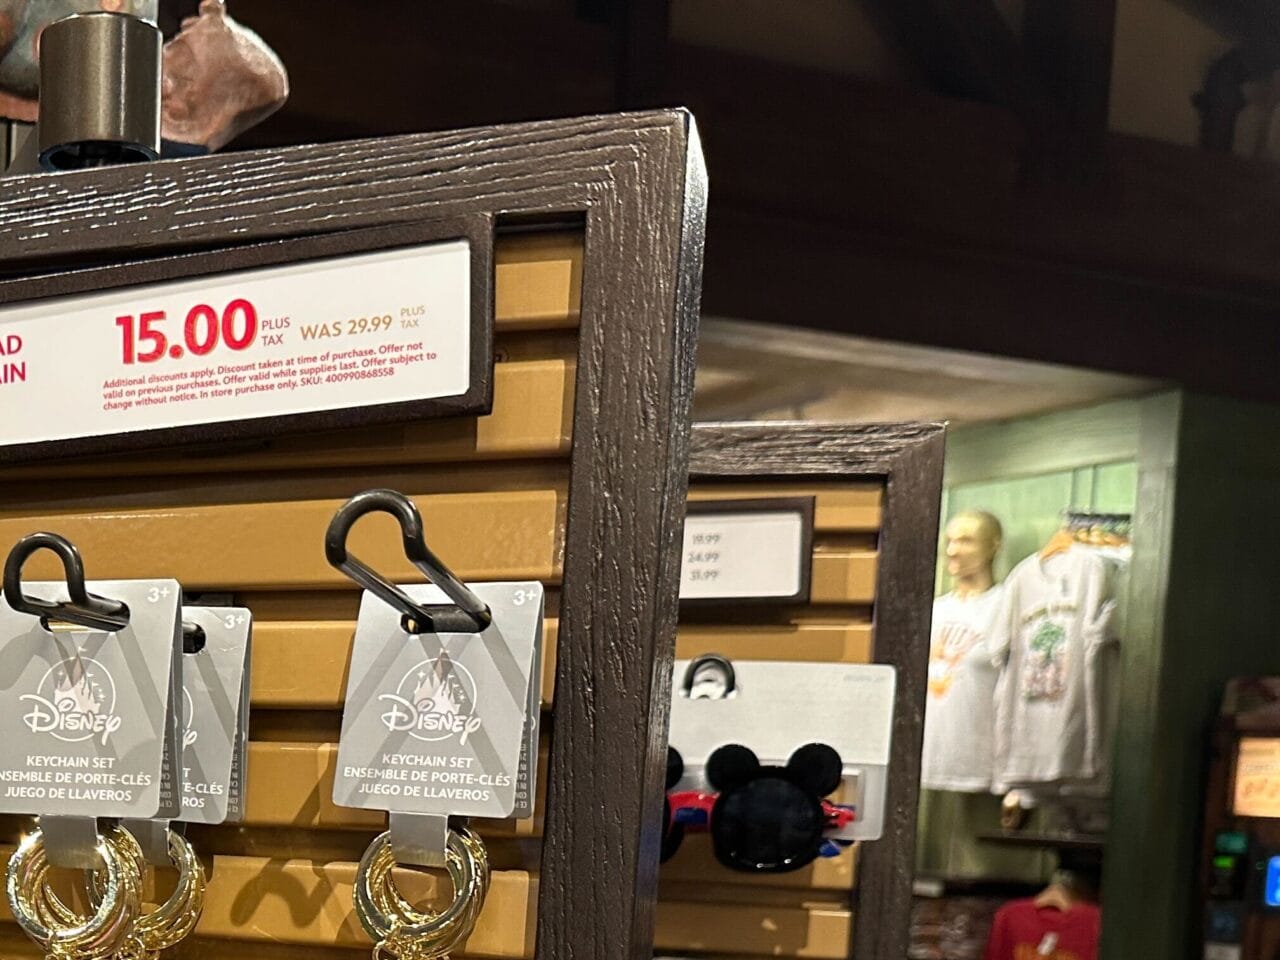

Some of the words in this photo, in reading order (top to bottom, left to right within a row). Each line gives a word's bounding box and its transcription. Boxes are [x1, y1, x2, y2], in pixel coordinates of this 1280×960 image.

[400, 305, 425, 317] PLUS
[116, 298, 258, 365] 15.00
[262, 317, 290, 330] PLUS
[300, 322, 342, 340] WAS
[347, 315, 393, 335] 29.99
[400, 319, 419, 329] TAX
[262, 334, 284, 346] TAX
[103, 375, 146, 389] Additional
[148, 371, 188, 384] discounts
[190, 368, 216, 379] apply.
[217, 362, 256, 375] Discount
[258, 359, 284, 371] taken
[286, 358, 295, 367] at
[297, 355, 318, 365] time
[320, 352, 330, 362] of
[332, 349, 377, 363] purchase.
[378, 342, 405, 355] Offer
[406, 341, 423, 351] not
[103, 388, 123, 400] valid
[125, 388, 136, 398] on
[138, 384, 174, 398] previous
[176, 380, 221, 393] purchases.
[223, 373, 247, 385] Offer
[248, 370, 270, 382] valid
[272, 365, 297, 379] while
[299, 361, 337, 376] supplies
[339, 359, 360, 371] last.
[362, 356, 387, 368] Offer
[389, 352, 424, 366] subject
[426, 350, 437, 361] to
[103, 400, 133, 411] change
[135, 395, 168, 407] without
[170, 391, 198, 403] notice.
[199, 390, 209, 399] In
[211, 387, 233, 397] store
[235, 383, 275, 396] purchase
[277, 380, 299, 392] only.
[300, 376, 323, 387] SKU:
[325, 367, 395, 383] 400990868558
[147, 587, 171, 603] 3+
[513, 590, 537, 606] 3+
[224, 613, 245, 629] 3+
[19, 693, 121, 746] Disney
[378, 693, 482, 746] Disney
[26, 755, 89, 767] KEYCHAIN
[92, 758, 115, 768] SET
[382, 753, 446, 767] KEYCHAIN
[450, 757, 473, 768] SET
[55, 773, 72, 783] DE
[75, 772, 151, 785] PORTE-CLÉS
[344, 766, 408, 780] ENSEMBLE
[411, 770, 428, 781] DE
[431, 772, 511, 786] PORTE-CLÉS
[5, 786, 45, 798] JUEGO
[48, 788, 66, 799] DE
[68, 789, 132, 801] LLAVEROS
[359, 783, 400, 796] JUEGO
[403, 786, 421, 796] DE
[424, 787, 490, 801] LLAVEROS
